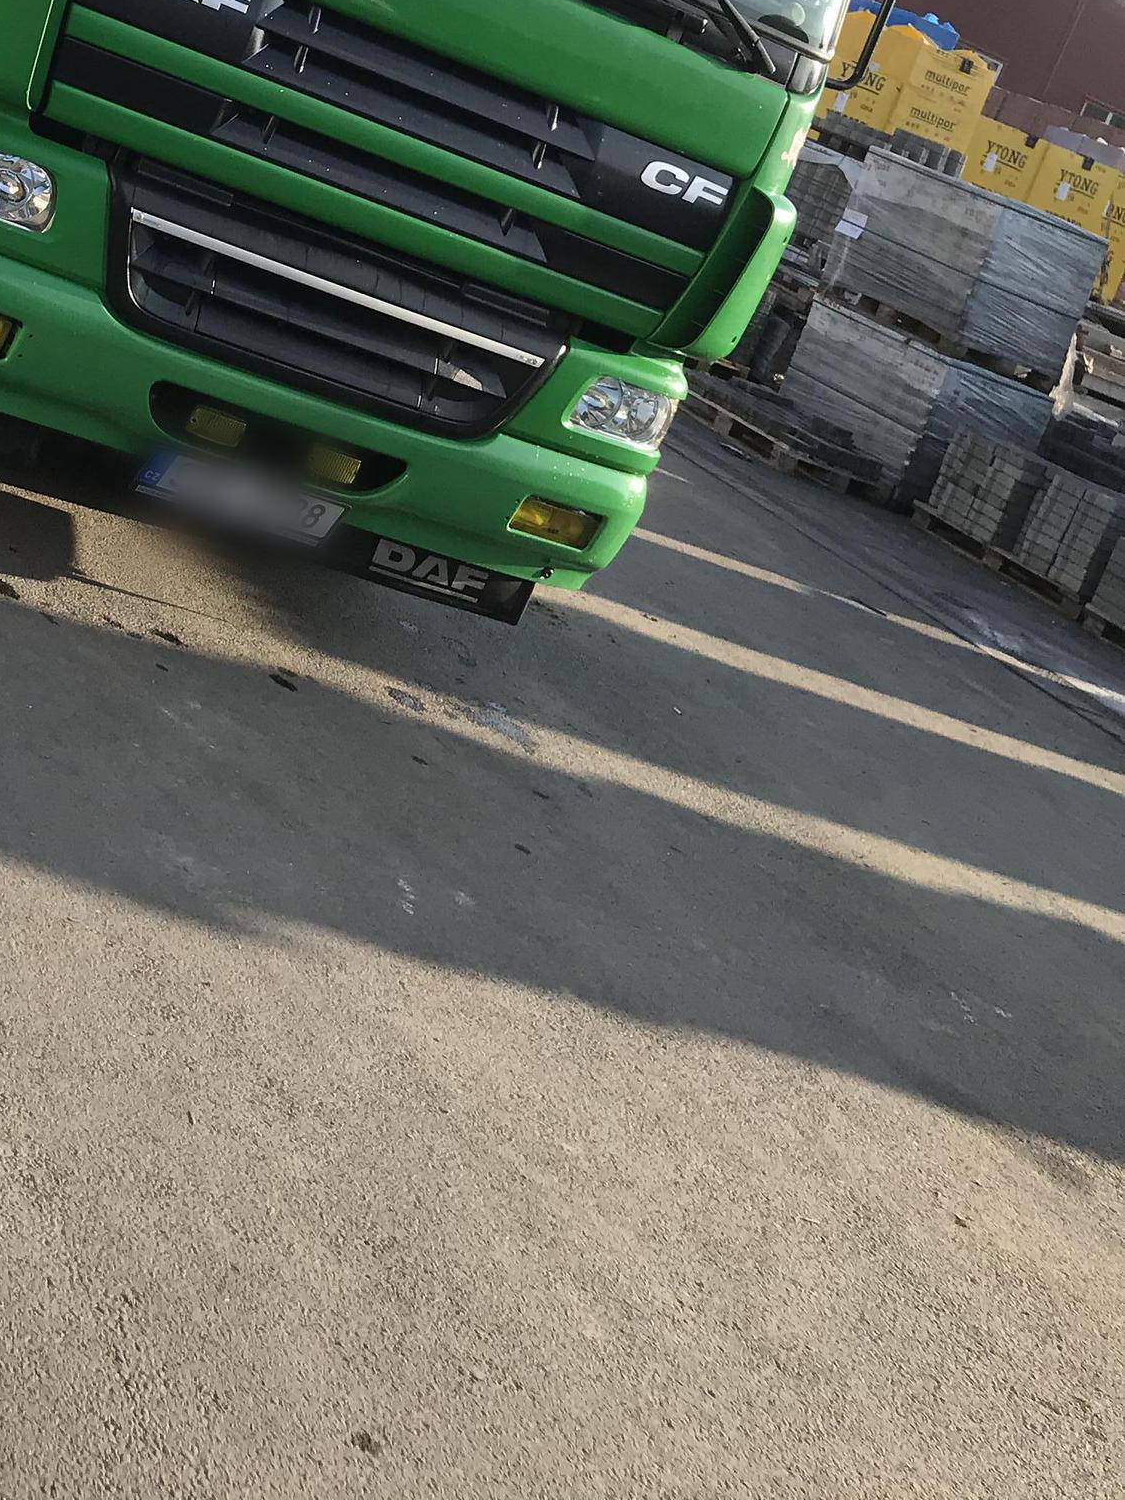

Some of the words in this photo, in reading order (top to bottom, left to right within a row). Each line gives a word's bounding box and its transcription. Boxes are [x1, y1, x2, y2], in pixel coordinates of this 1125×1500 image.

[924, 69, 972, 94] multipor
[909, 106, 956, 130] multipor
[986, 139, 1028, 169] YTONG
[640, 160, 729, 206] CF
[1059, 168, 1100, 196] YTONG
[144, 469, 162, 482] CZ
[371, 538, 490, 591] DAF
